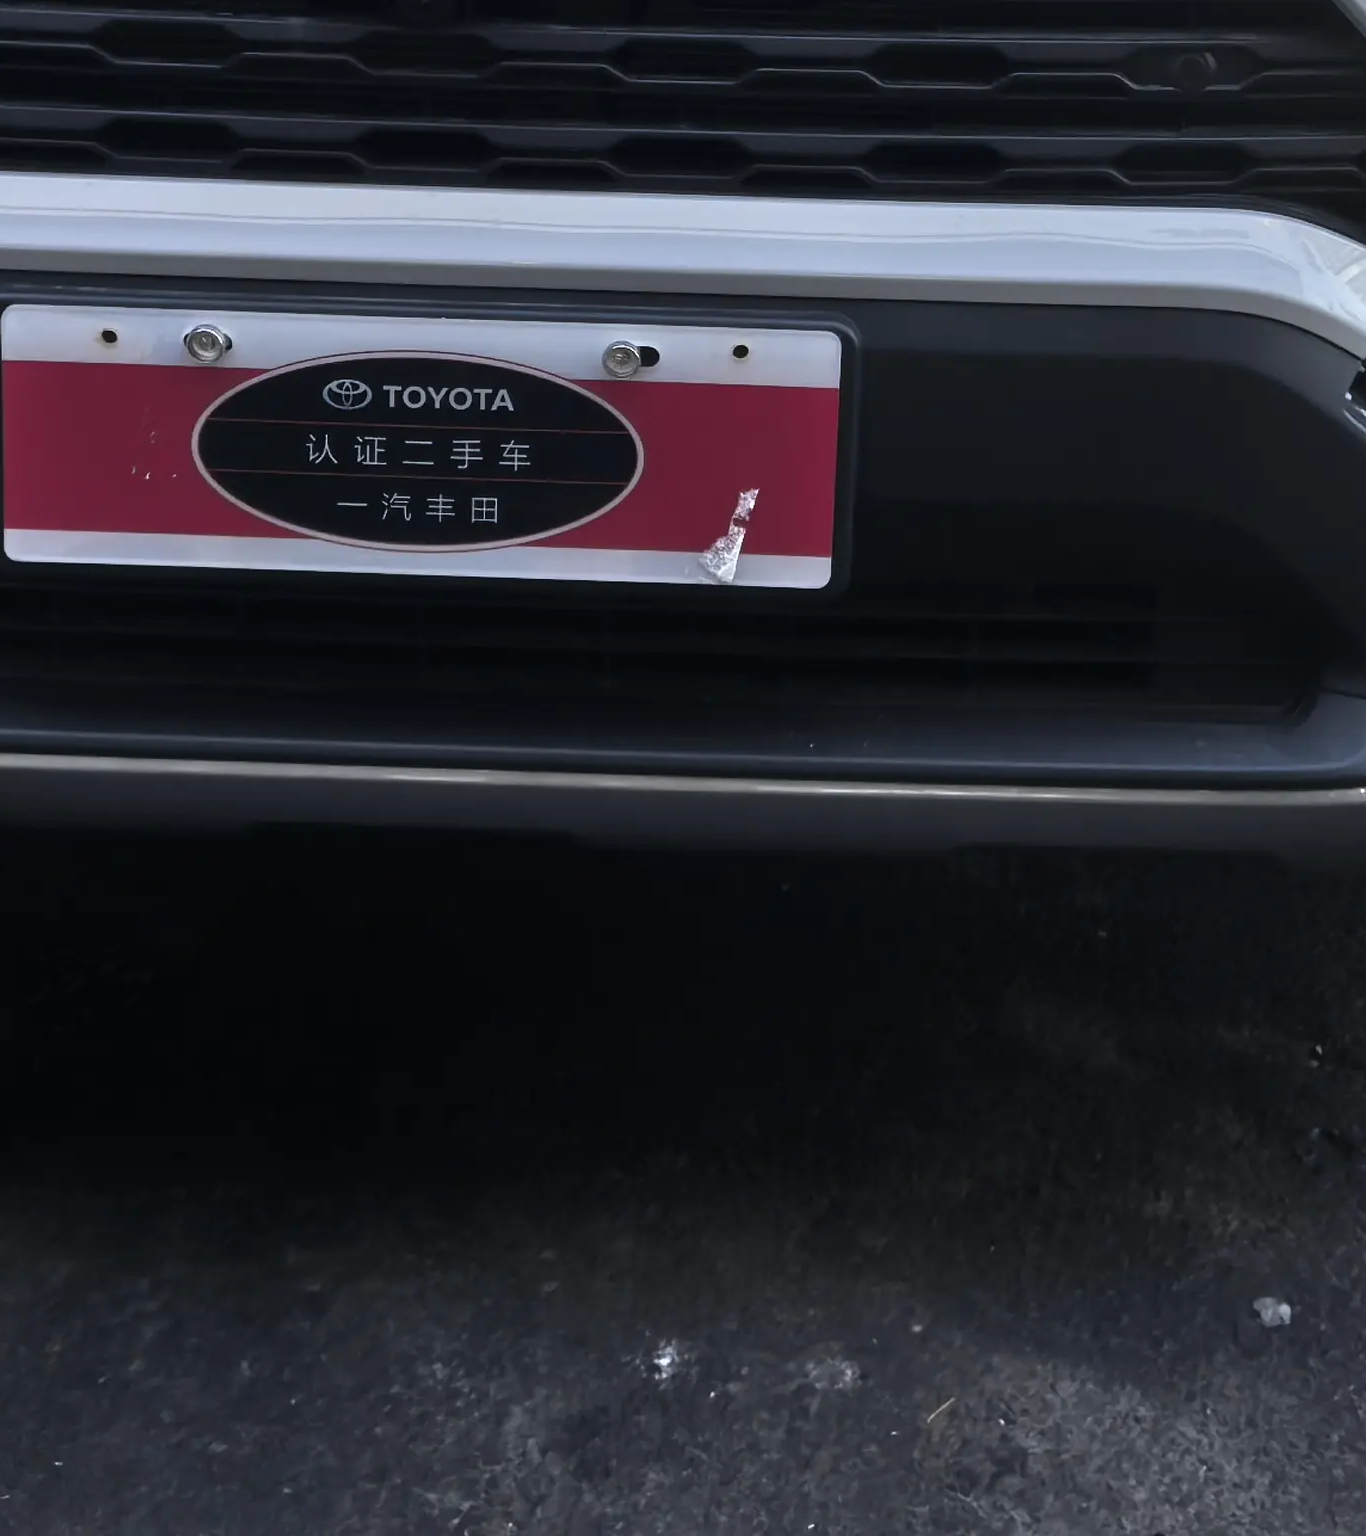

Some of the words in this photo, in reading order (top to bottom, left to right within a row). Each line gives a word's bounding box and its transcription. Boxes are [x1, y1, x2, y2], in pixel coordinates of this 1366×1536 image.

[383, 384, 515, 411] TOYOTA
[306, 433, 532, 472] 认证二手车
[336, 492, 499, 524] 一汽丰田
